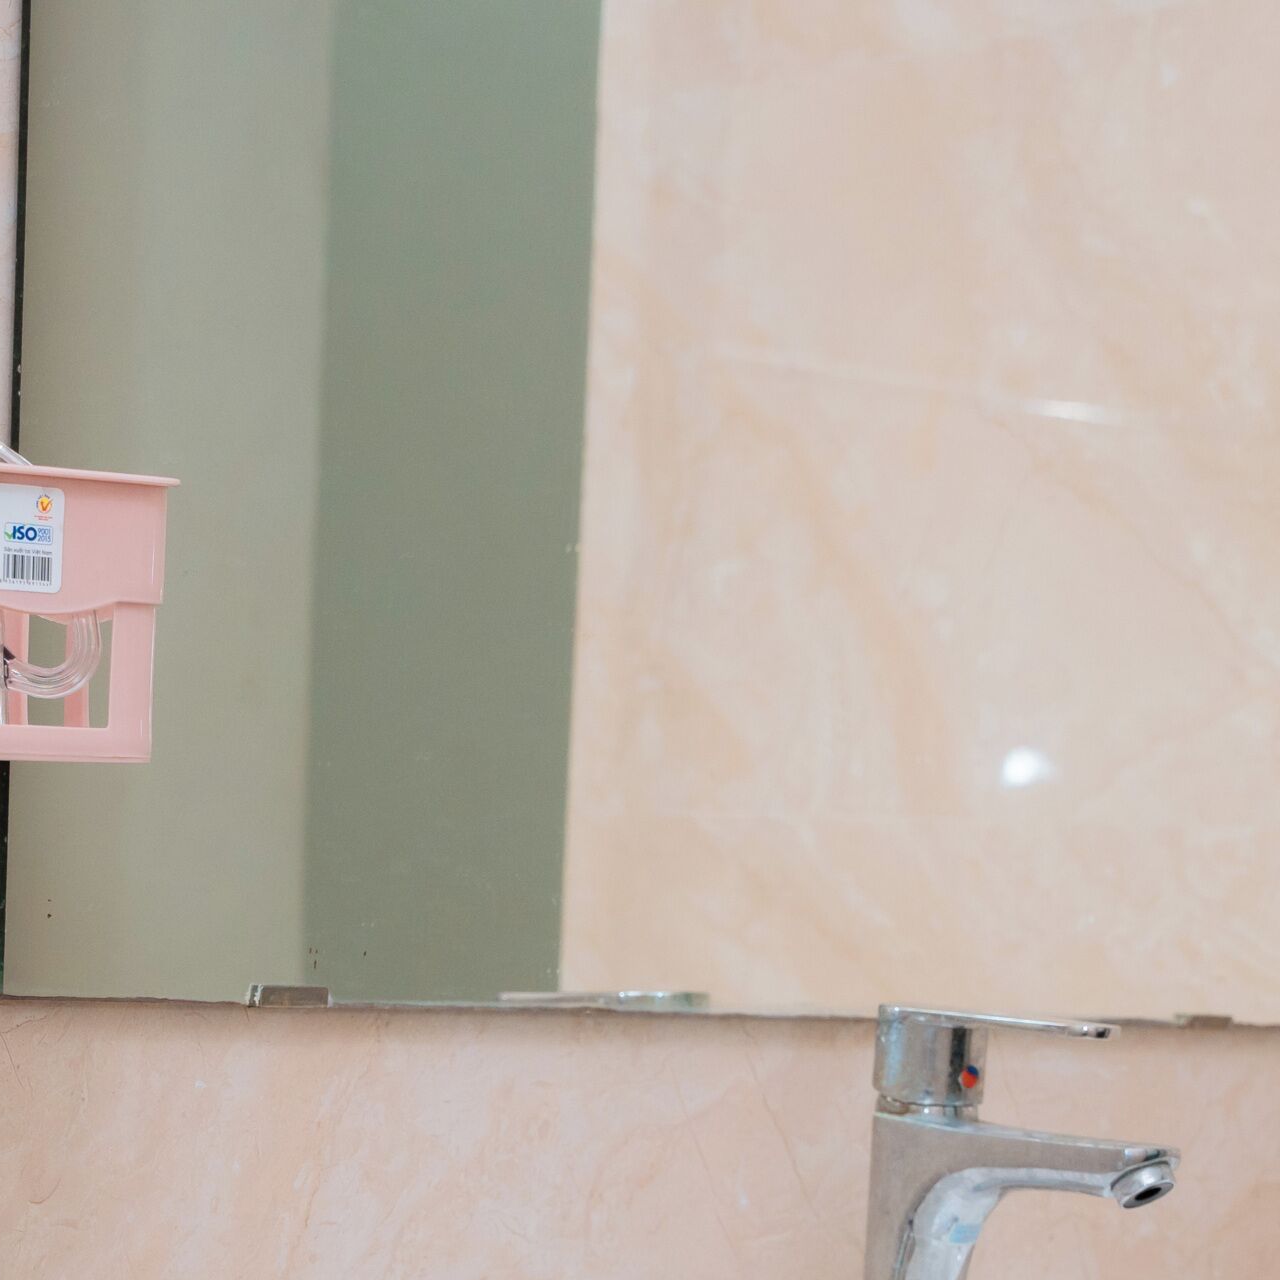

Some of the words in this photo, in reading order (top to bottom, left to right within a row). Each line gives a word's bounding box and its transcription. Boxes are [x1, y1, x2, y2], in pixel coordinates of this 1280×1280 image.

[12, 525, 38, 541] ISO
[38, 527, 51, 535] 9001
[37, 534, 51, 543] 2015
